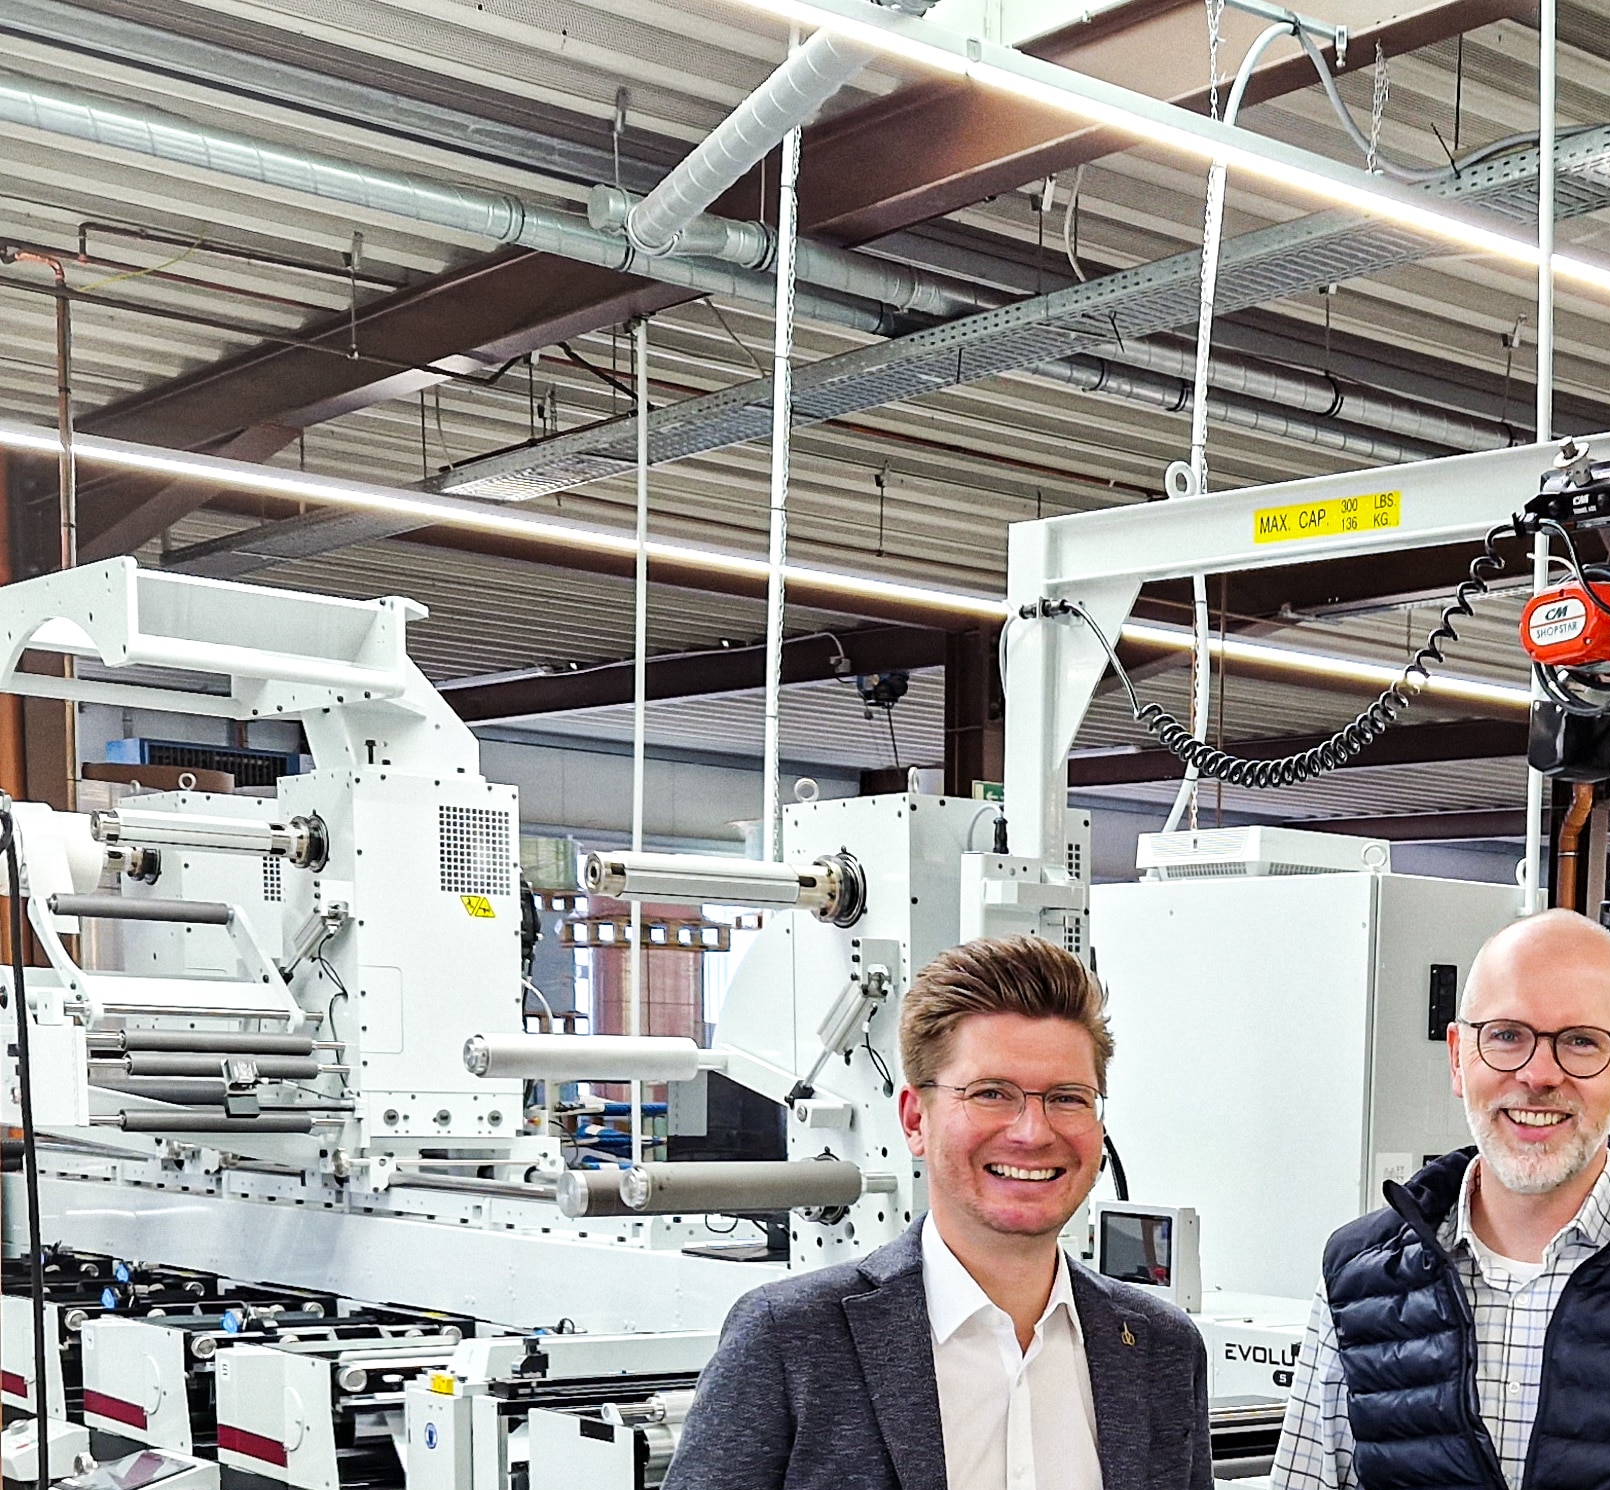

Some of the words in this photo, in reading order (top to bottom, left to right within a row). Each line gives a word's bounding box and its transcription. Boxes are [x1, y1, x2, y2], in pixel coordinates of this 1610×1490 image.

[1341, 498, 1358, 514] 300
[1374, 493, 1397, 509] LBS.
[1259, 514, 1291, 534] MAX.
[1298, 508, 1329, 529] CAP.
[1341, 516, 1358, 532] 136
[1544, 605, 1569, 621] CM
[1536, 621, 1578, 639] SHOPSTAR
